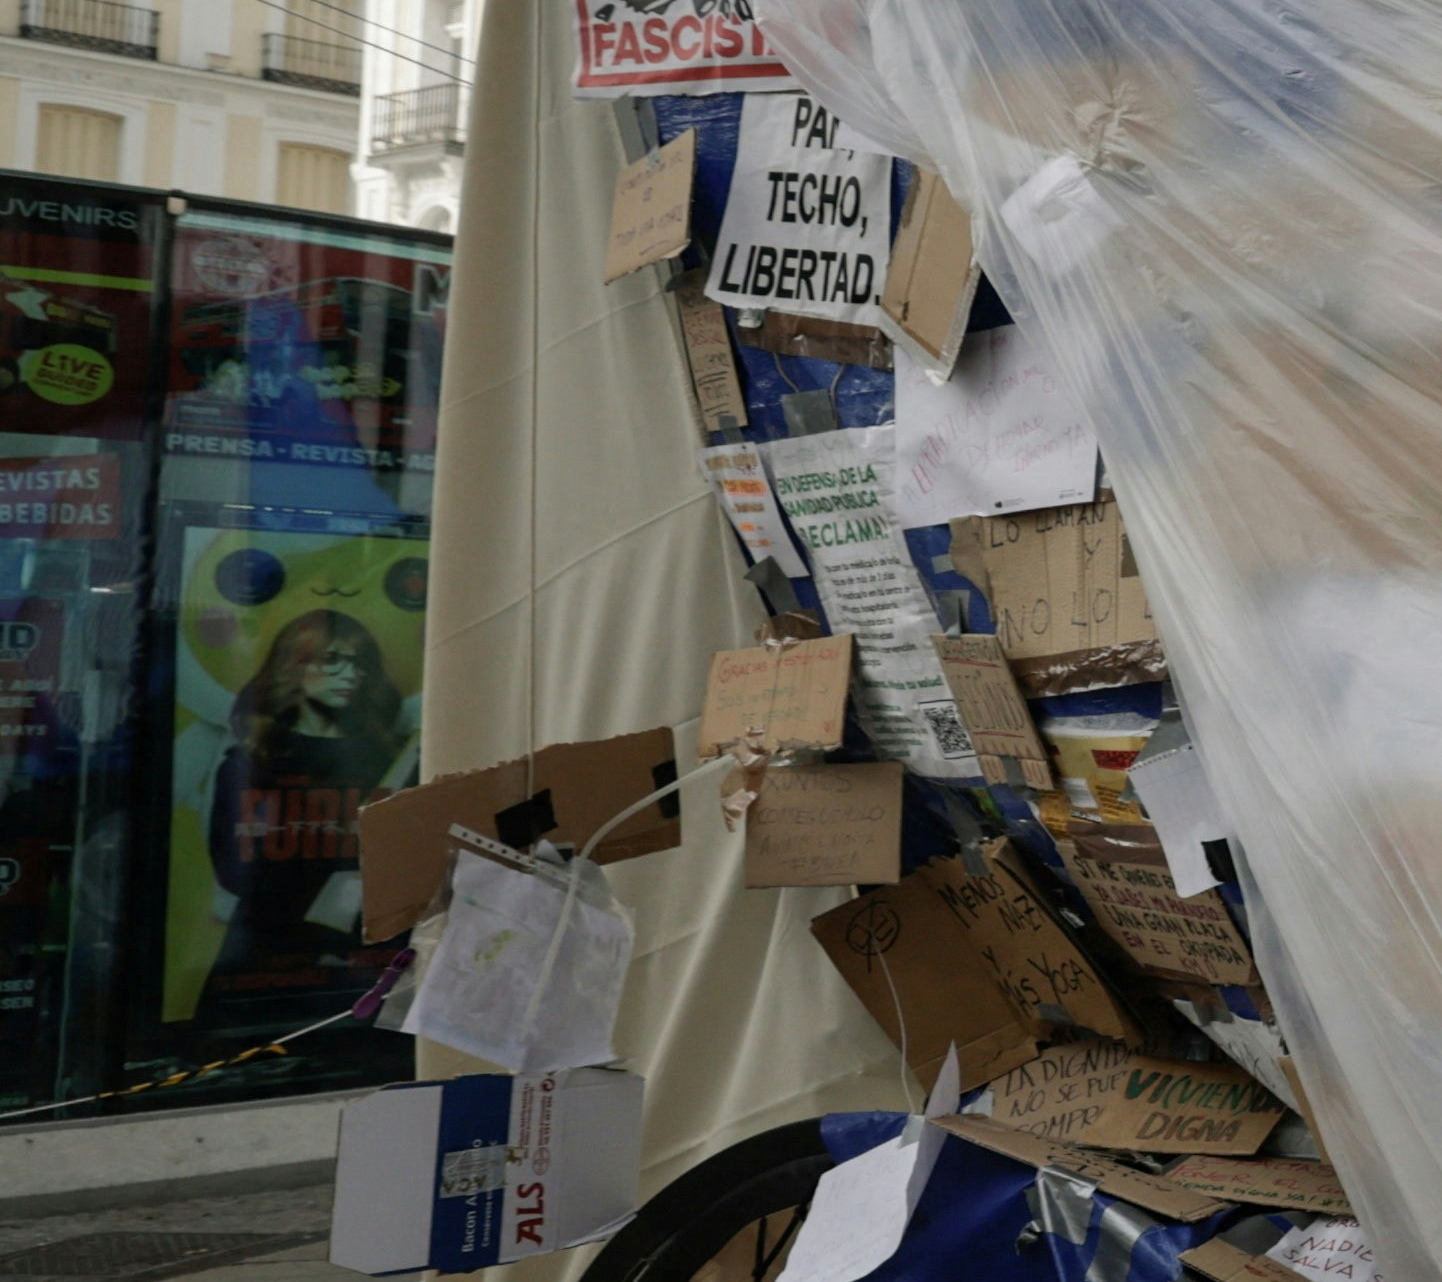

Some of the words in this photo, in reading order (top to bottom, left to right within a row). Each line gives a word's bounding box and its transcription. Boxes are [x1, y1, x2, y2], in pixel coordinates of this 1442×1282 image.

[766, 171, 870, 238] TECHO,
[716, 242, 883, 307] LIBERTAD.
[165, 433, 271, 457] PRENSA
[291, 443, 393, 468] REVISTA
[937, 873, 1005, 929] MENOS
[1135, 1111, 1242, 1143] DIGNA
[516, 1182, 545, 1246] ALS
